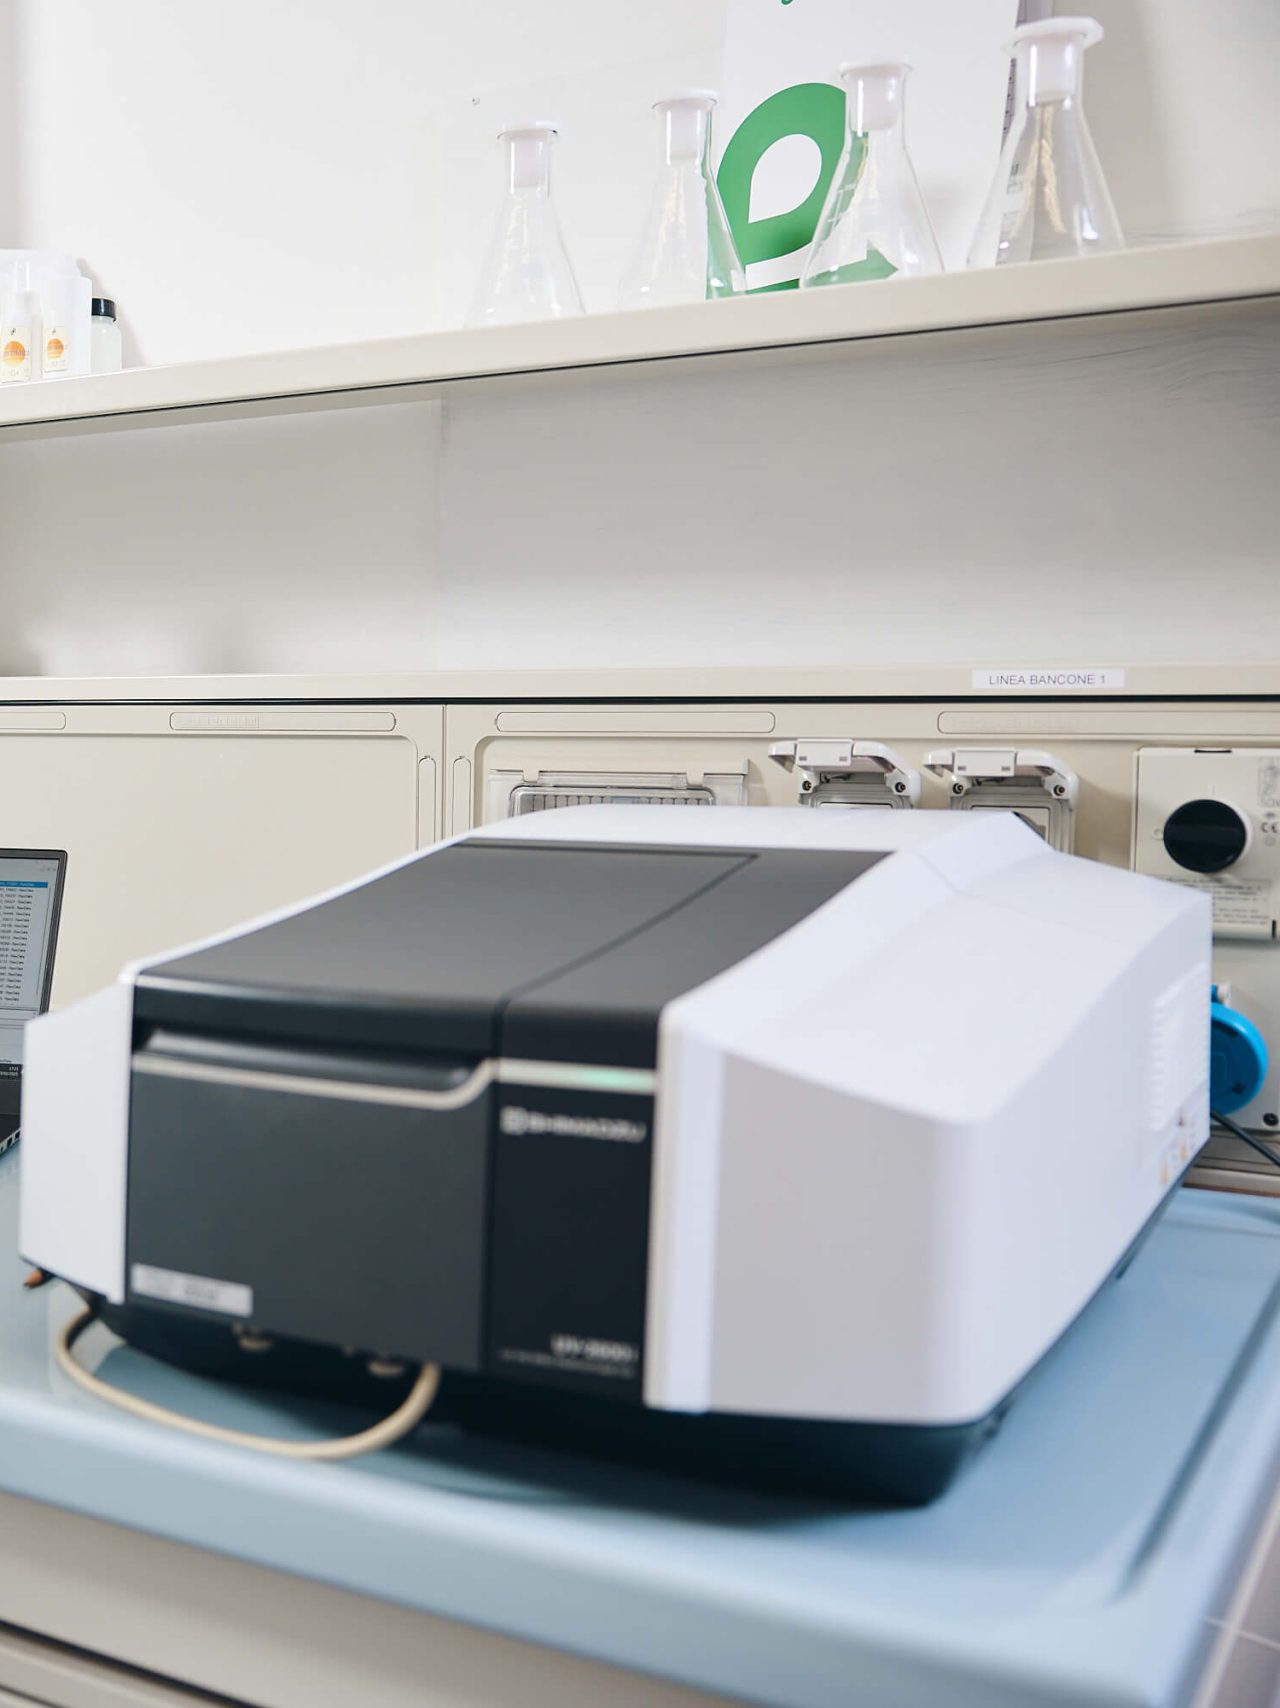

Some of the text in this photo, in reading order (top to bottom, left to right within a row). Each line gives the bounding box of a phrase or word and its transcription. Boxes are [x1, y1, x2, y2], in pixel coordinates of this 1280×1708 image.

[989, 674, 1106, 686] LINEA BANCONE 1
